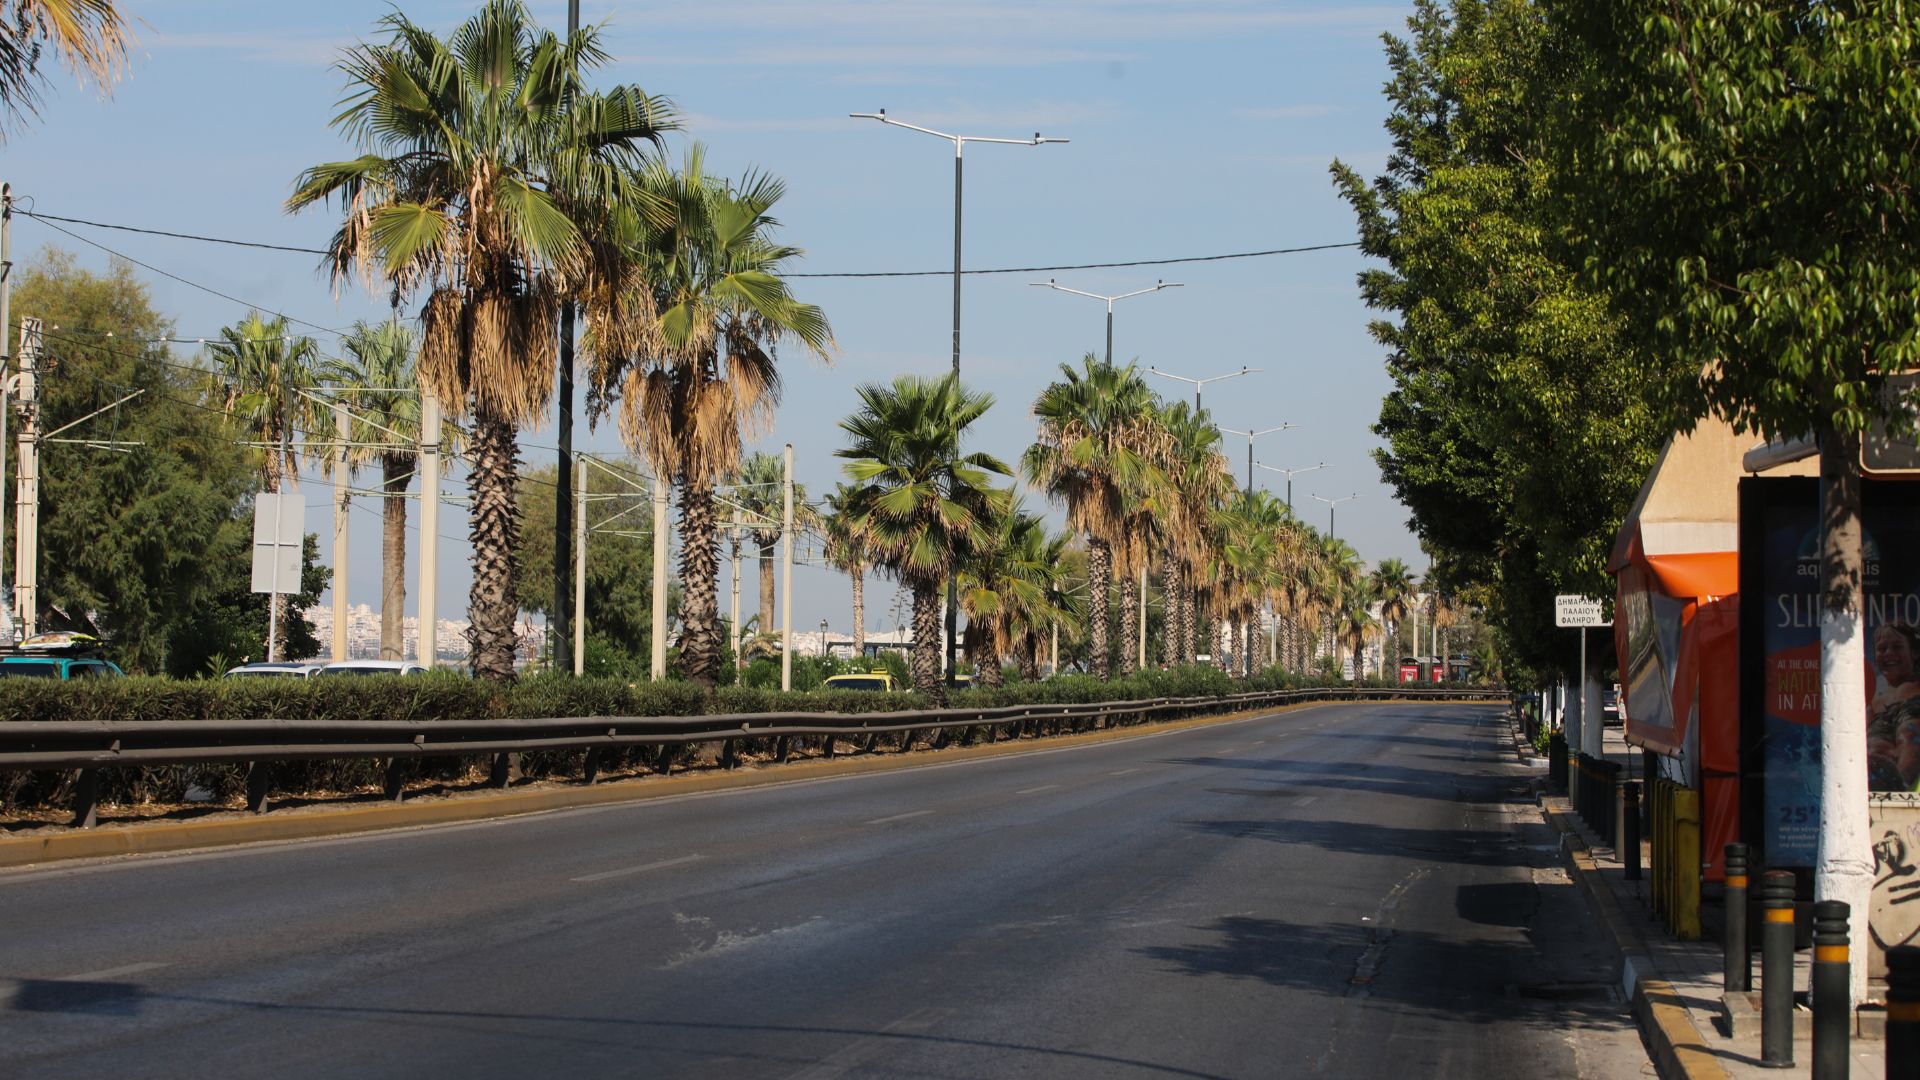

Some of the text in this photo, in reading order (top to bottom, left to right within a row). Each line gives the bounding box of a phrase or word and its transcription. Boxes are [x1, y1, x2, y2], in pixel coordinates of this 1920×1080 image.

[1777, 593, 1920, 629] SLI NTO
[1778, 659, 1786, 670] AT
[1789, 659, 1802, 670] THE
[1778, 693, 1794, 711] IN
